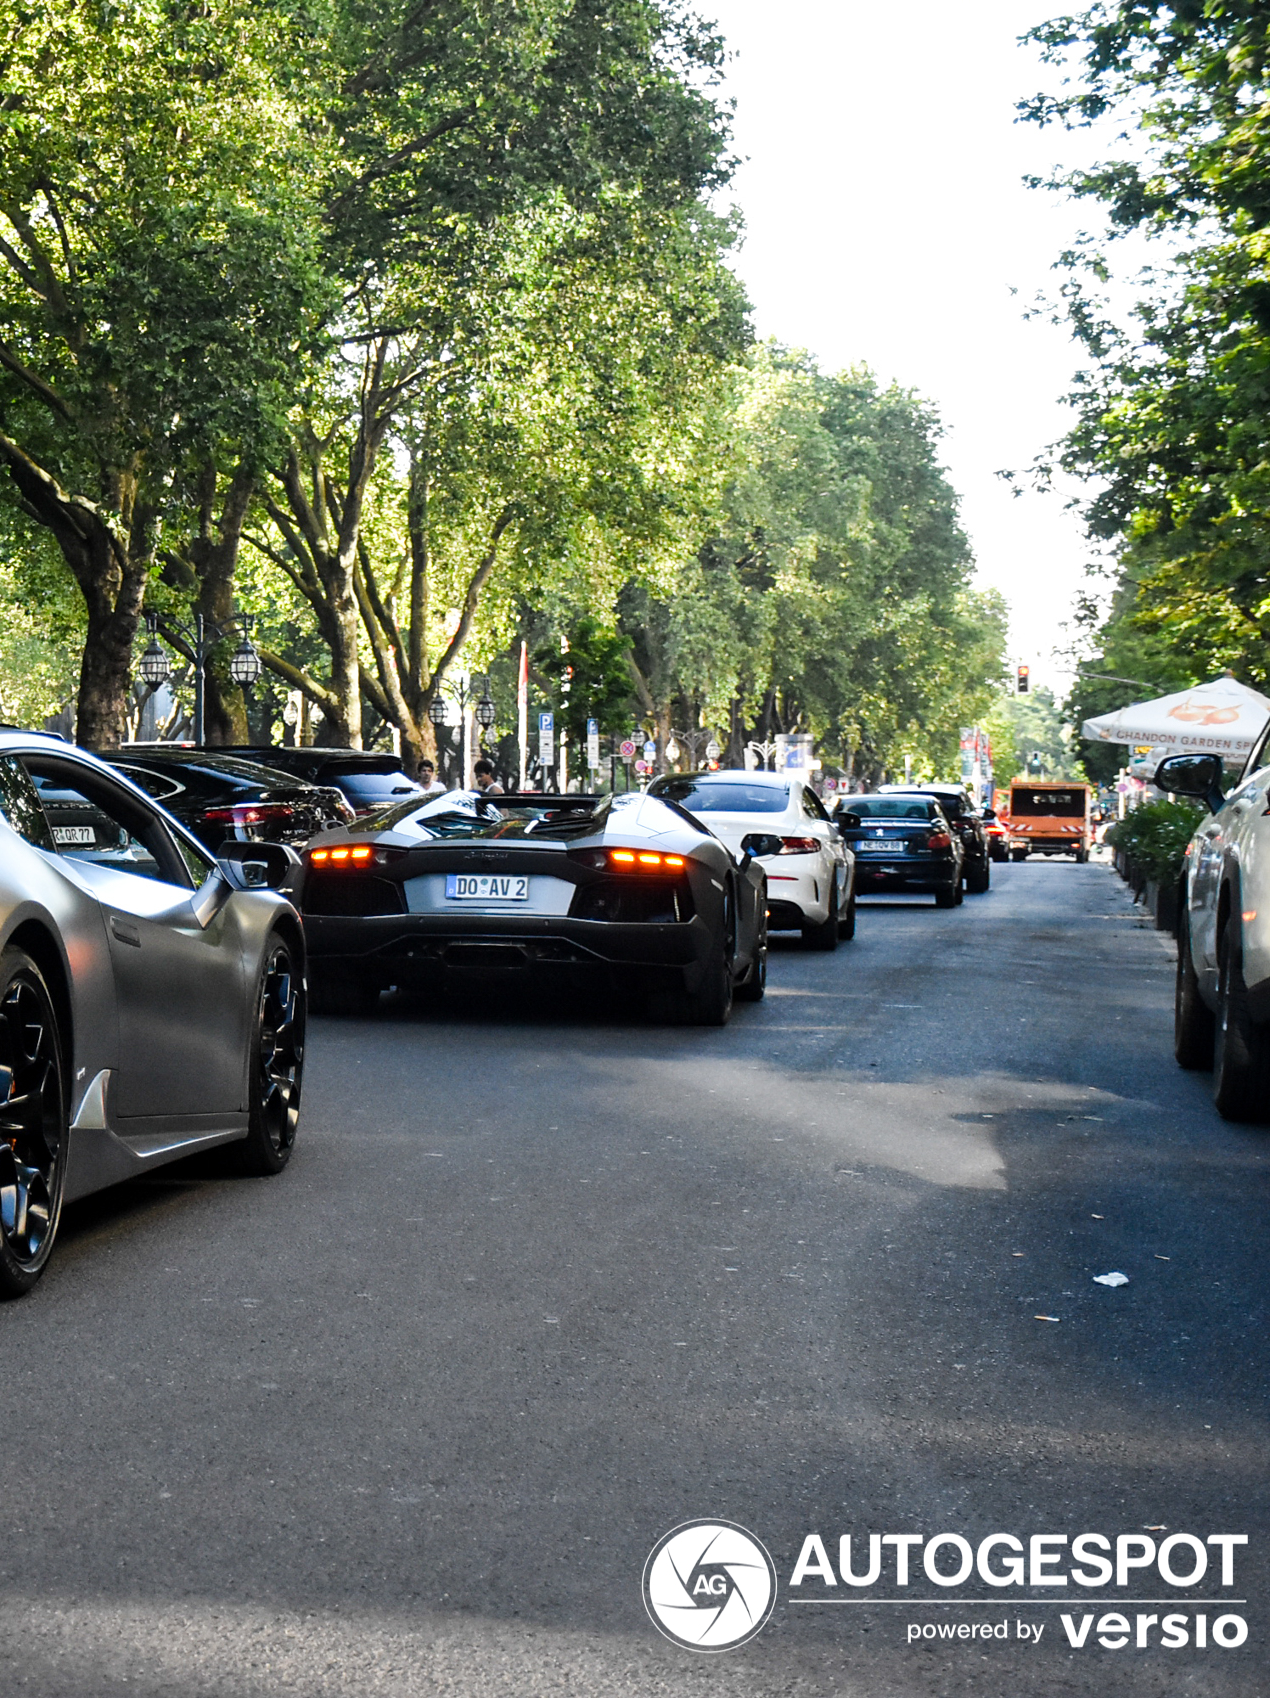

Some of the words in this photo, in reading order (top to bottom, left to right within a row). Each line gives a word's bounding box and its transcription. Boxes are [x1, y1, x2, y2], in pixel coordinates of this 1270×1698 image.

[542, 715, 550, 729] P
[1116, 730, 1177, 744] CHANDON
[1181, 736, 1232, 749] GARDEN
[457, 877, 478, 895] DO
[489, 878, 511, 896] AV
[515, 879, 526, 896] 2
